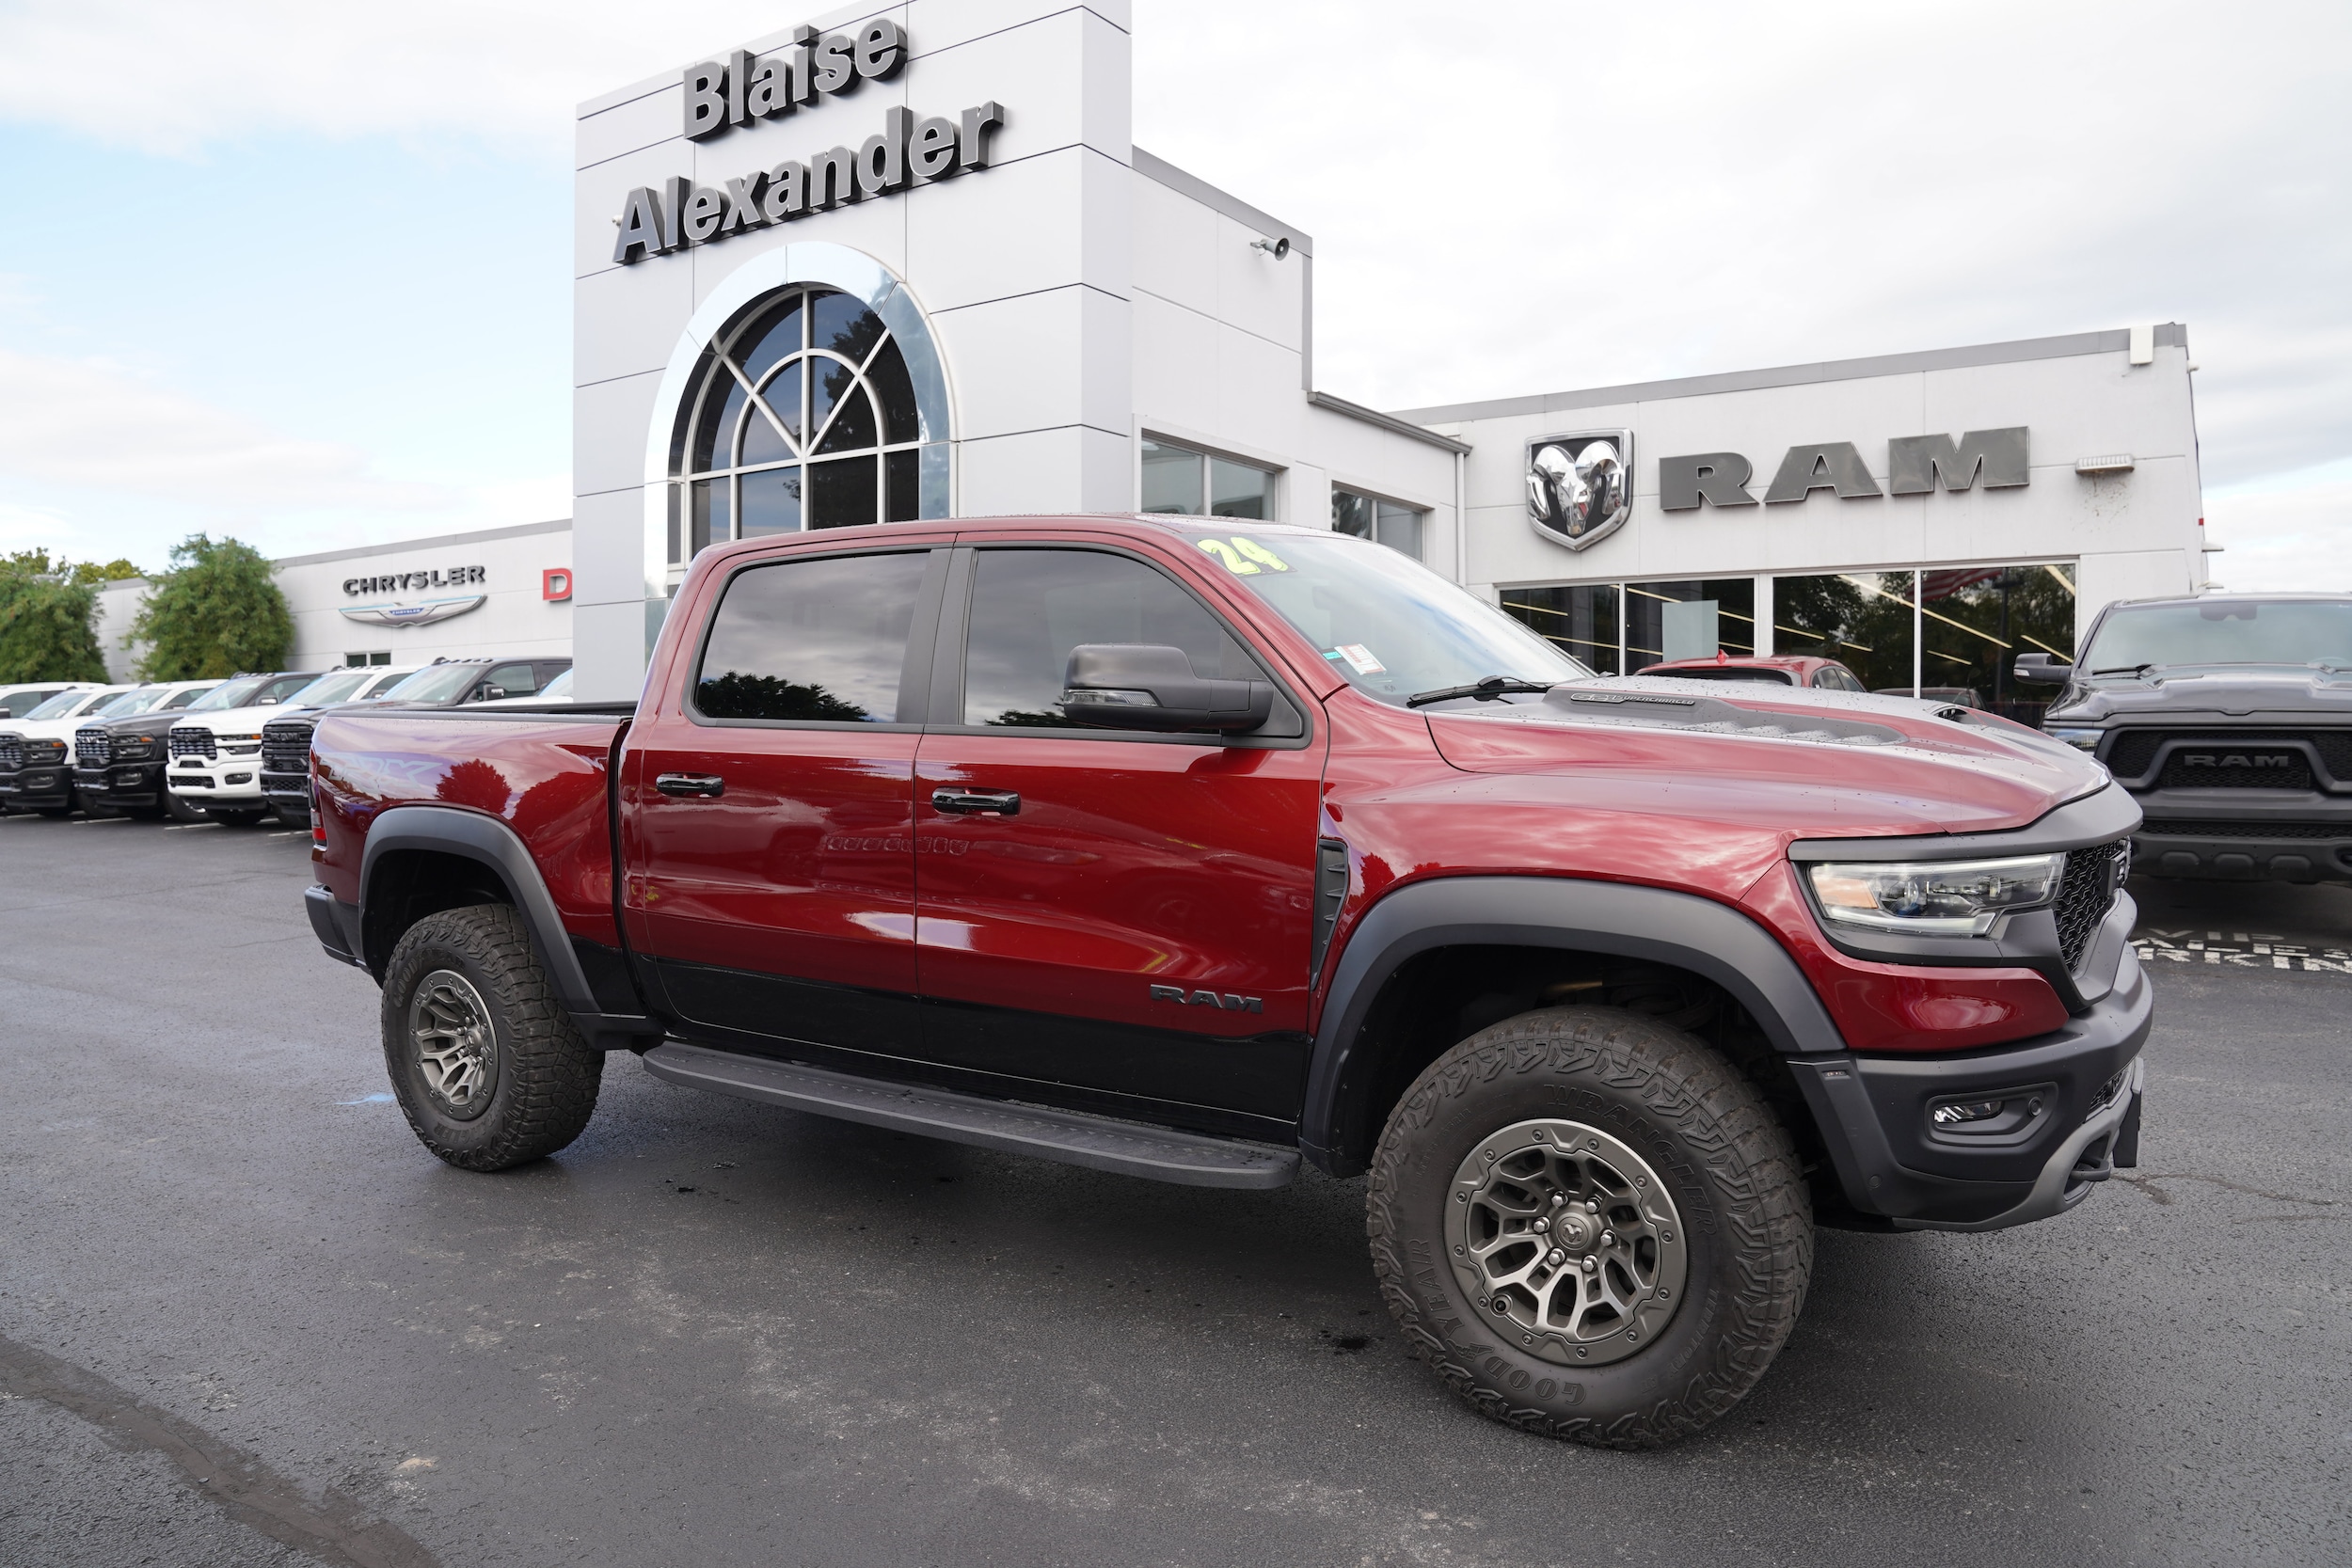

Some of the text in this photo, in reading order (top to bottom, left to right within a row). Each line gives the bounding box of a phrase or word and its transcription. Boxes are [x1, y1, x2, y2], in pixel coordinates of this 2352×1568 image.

[683, 17, 909, 143] Blaise
[612, 101, 1006, 264] Alexander
[1659, 426, 2030, 511] RAM
[1197, 536, 1289, 576] 24
[342, 565, 486, 596] CHRYSLER
[2184, 755, 2289, 767] RAM
[2129, 937, 2352, 959] ALES
[2148, 927, 2285, 942] VIP
[2137, 947, 2352, 974] RKIN
[1150, 984, 1263, 1014] RAM
[1543, 1084, 1718, 1237] WRANGLER
[1410, 1237, 1586, 1405] GOODYEAR
